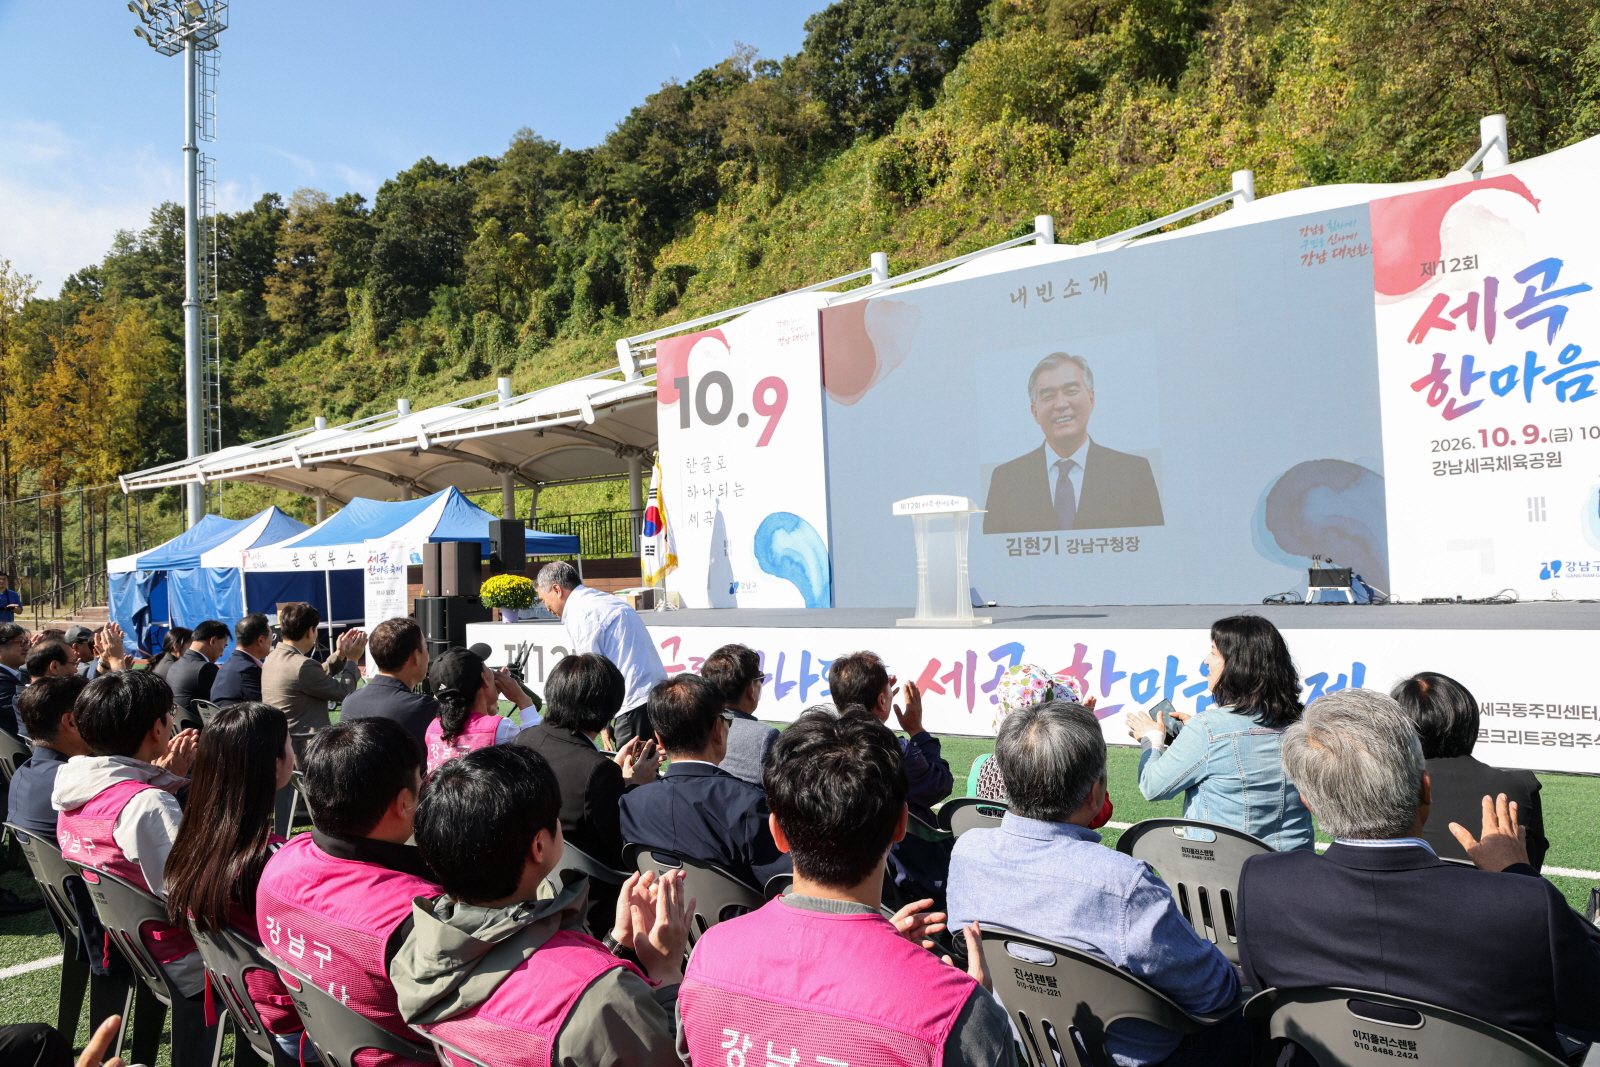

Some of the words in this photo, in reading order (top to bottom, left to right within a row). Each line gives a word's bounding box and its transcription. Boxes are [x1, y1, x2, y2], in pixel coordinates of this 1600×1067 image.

[1299, 224, 1325, 237] 강남을
[1326, 219, 1357, 232] 힘차게!
[1300, 237, 1325, 251] 구민을
[1327, 232, 1358, 245] 신나게!
[1300, 249, 1328, 266] 강남
[1421, 254, 1478, 277] 제12회
[1009, 270, 1108, 309] 내빈소개
[1407, 257, 1593, 346] 세곡
[1410, 343, 1600, 421] 한마음
[673, 370, 789, 448] 10.9
[686, 455, 727, 474] 한글로
[1432, 451, 1562, 477] 강남세곡체육공원
[687, 482, 745, 500] 하나되는
[688, 510, 714, 528] 세곡
[1006, 535, 1059, 557] 김현기
[1066, 536, 1140, 555] 강남구청장
[291, 550, 356, 568] 운영부스
[367, 552, 390, 565] 세곡
[1565, 561, 1600, 572] 강남구
[60, 830, 96, 856] 강남구
[266, 916, 332, 969] 강남구
[1013, 967, 1058, 988] 진성렌탈
[721, 1028, 850, 1067] 강남
[1352, 1029, 1417, 1051] 이지플러스렌탈
[1354, 1041, 1419, 1060] 010.8488.2424
